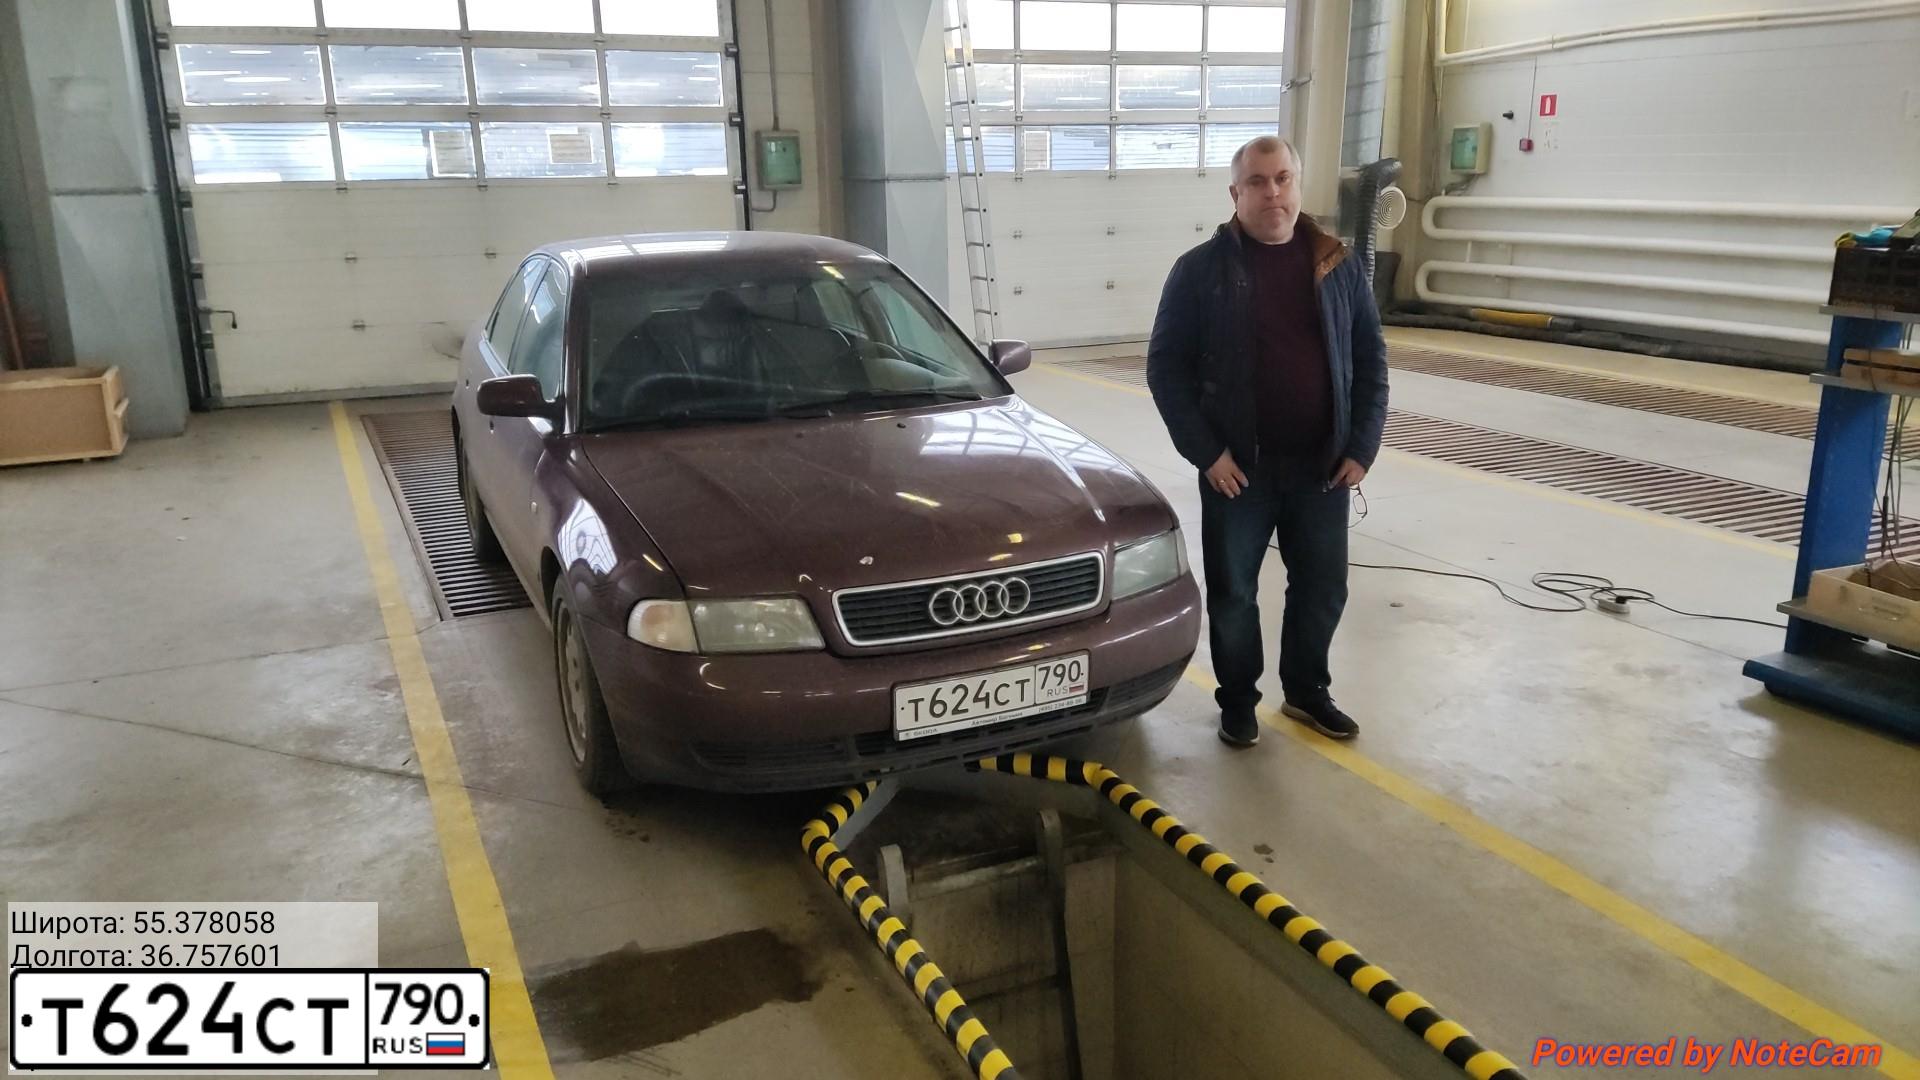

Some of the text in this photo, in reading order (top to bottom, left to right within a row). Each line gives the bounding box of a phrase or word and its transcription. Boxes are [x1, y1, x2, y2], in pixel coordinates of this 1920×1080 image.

[907, 660, 1082, 722] Т624СТ 790
[1046, 686, 1069, 697] RUS
